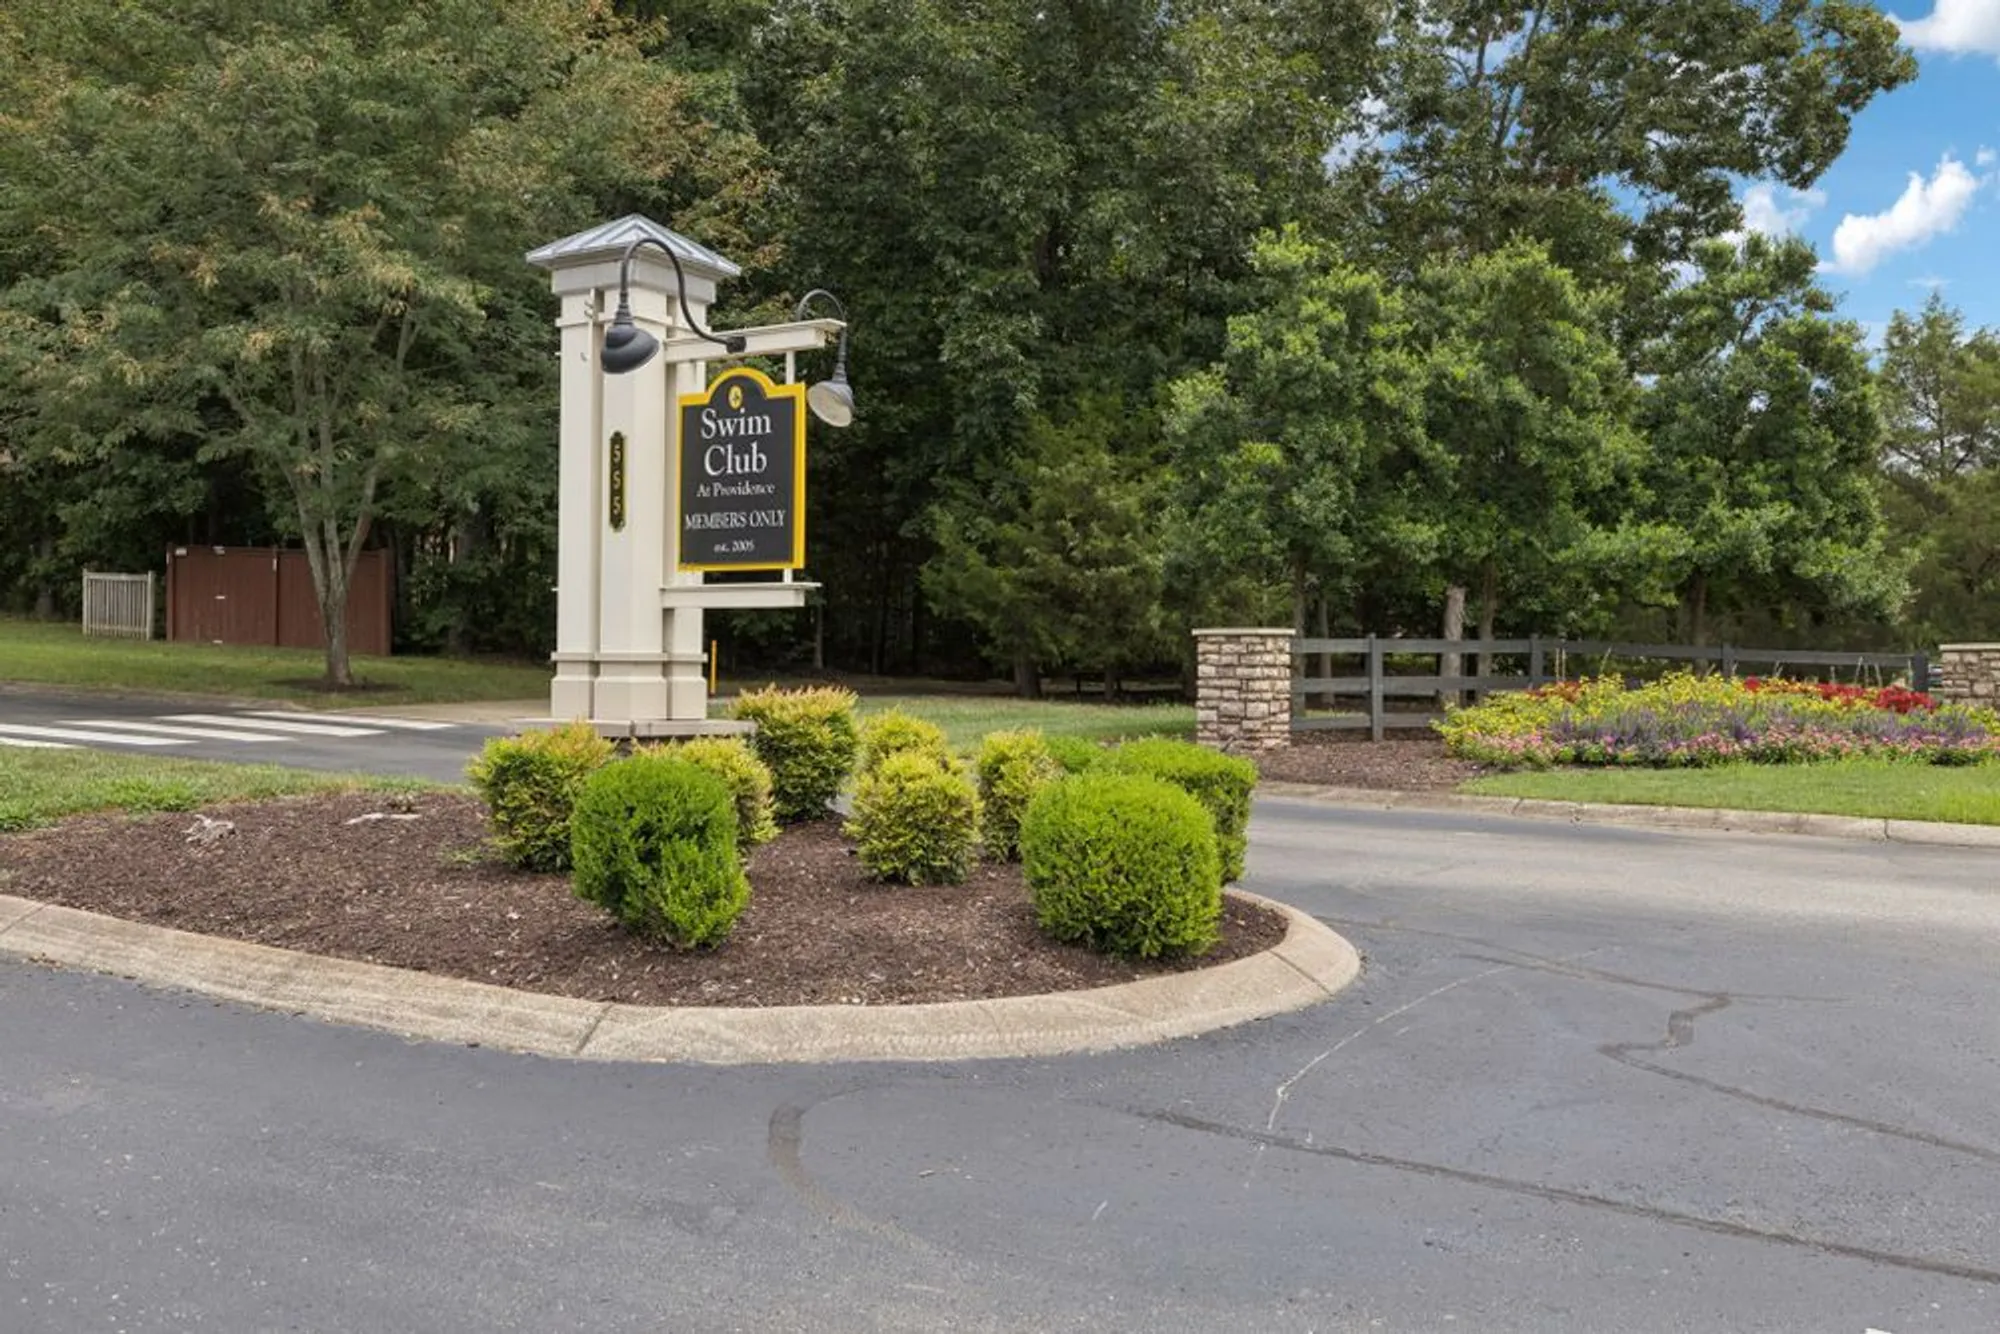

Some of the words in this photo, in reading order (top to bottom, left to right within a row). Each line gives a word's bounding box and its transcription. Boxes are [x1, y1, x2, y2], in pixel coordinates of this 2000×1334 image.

[700, 407, 772, 439] Swim
[704, 441, 768, 476] Club
[612, 443, 622, 515] 555
[696, 483, 711, 498] At
[712, 480, 775, 497] Providence
[685, 511, 747, 529] MEMBERS
[748, 509, 786, 528] ONLY
